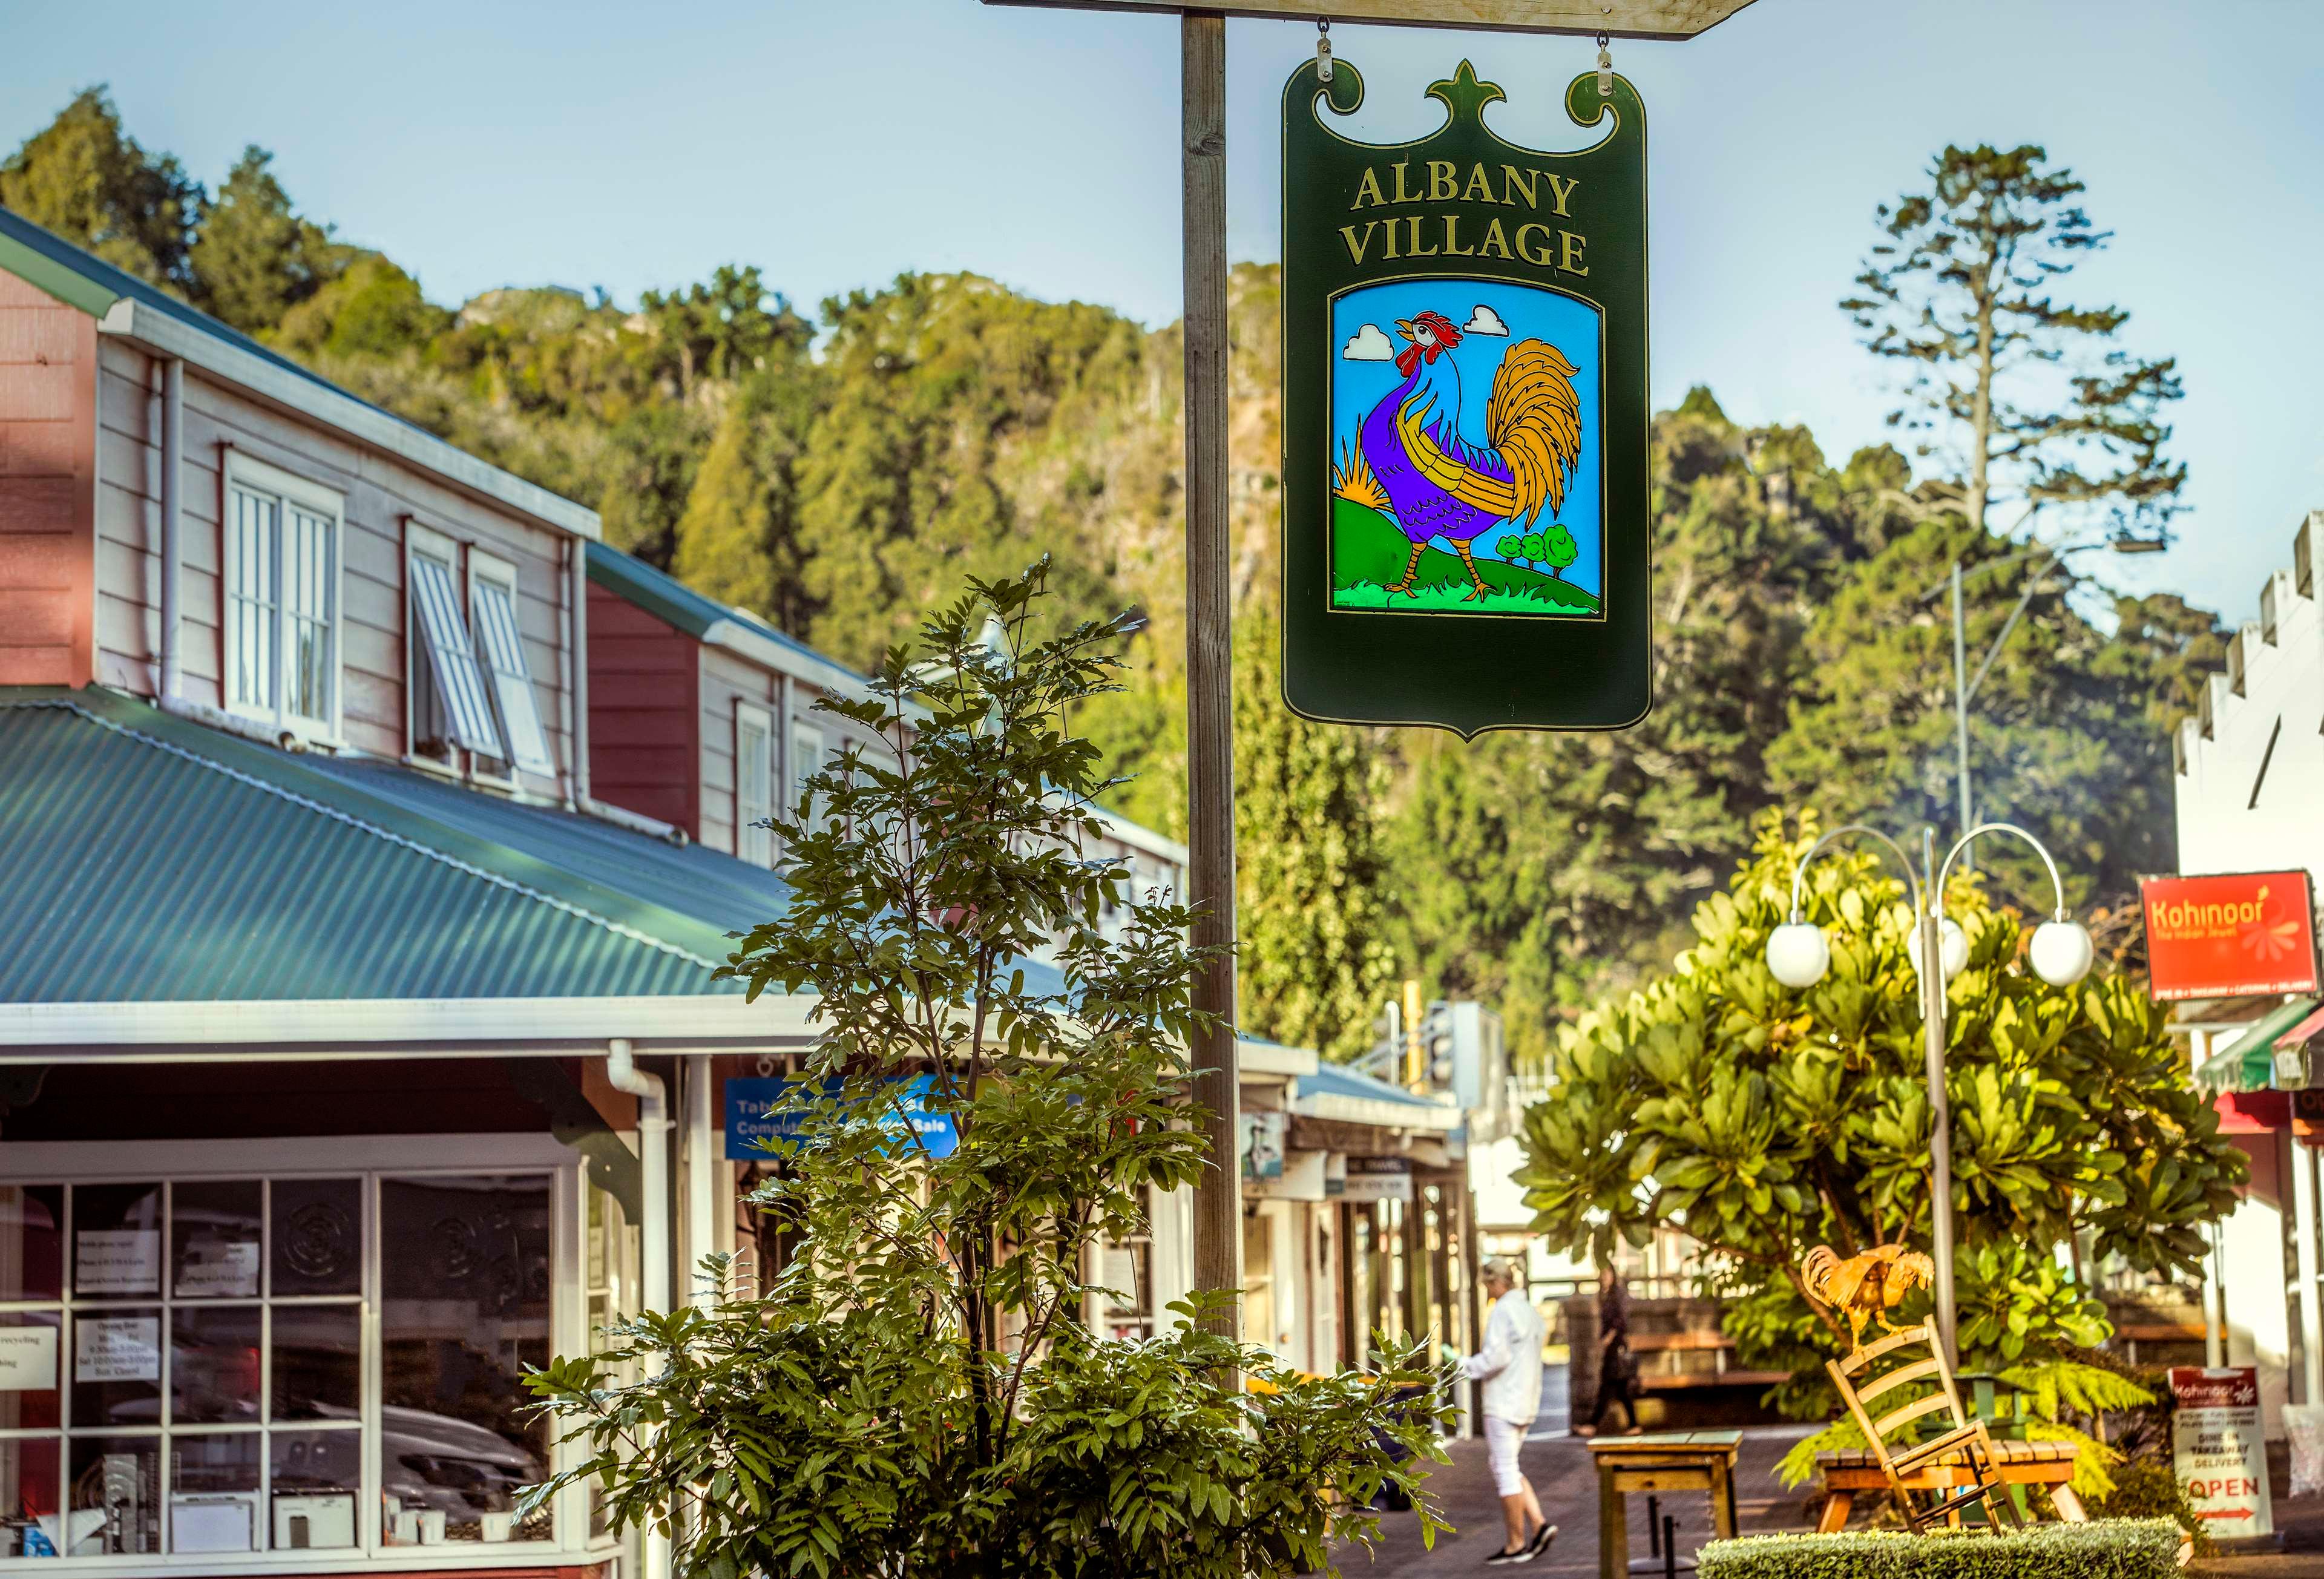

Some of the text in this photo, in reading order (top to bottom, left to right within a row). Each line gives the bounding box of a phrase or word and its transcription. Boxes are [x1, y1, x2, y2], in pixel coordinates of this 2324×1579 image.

[1350, 160, 1580, 218] ALBANY
[1338, 215, 1589, 277] VILLAGE
[913, 1118, 946, 1133] Sale
[1, 1335, 41, 1345] recycling
[2189, 1443, 2250, 1455] TAKEAWAY
[2194, 1456, 2248, 1468] DELIVERY
[2189, 1477, 2259, 1499] OPEN
